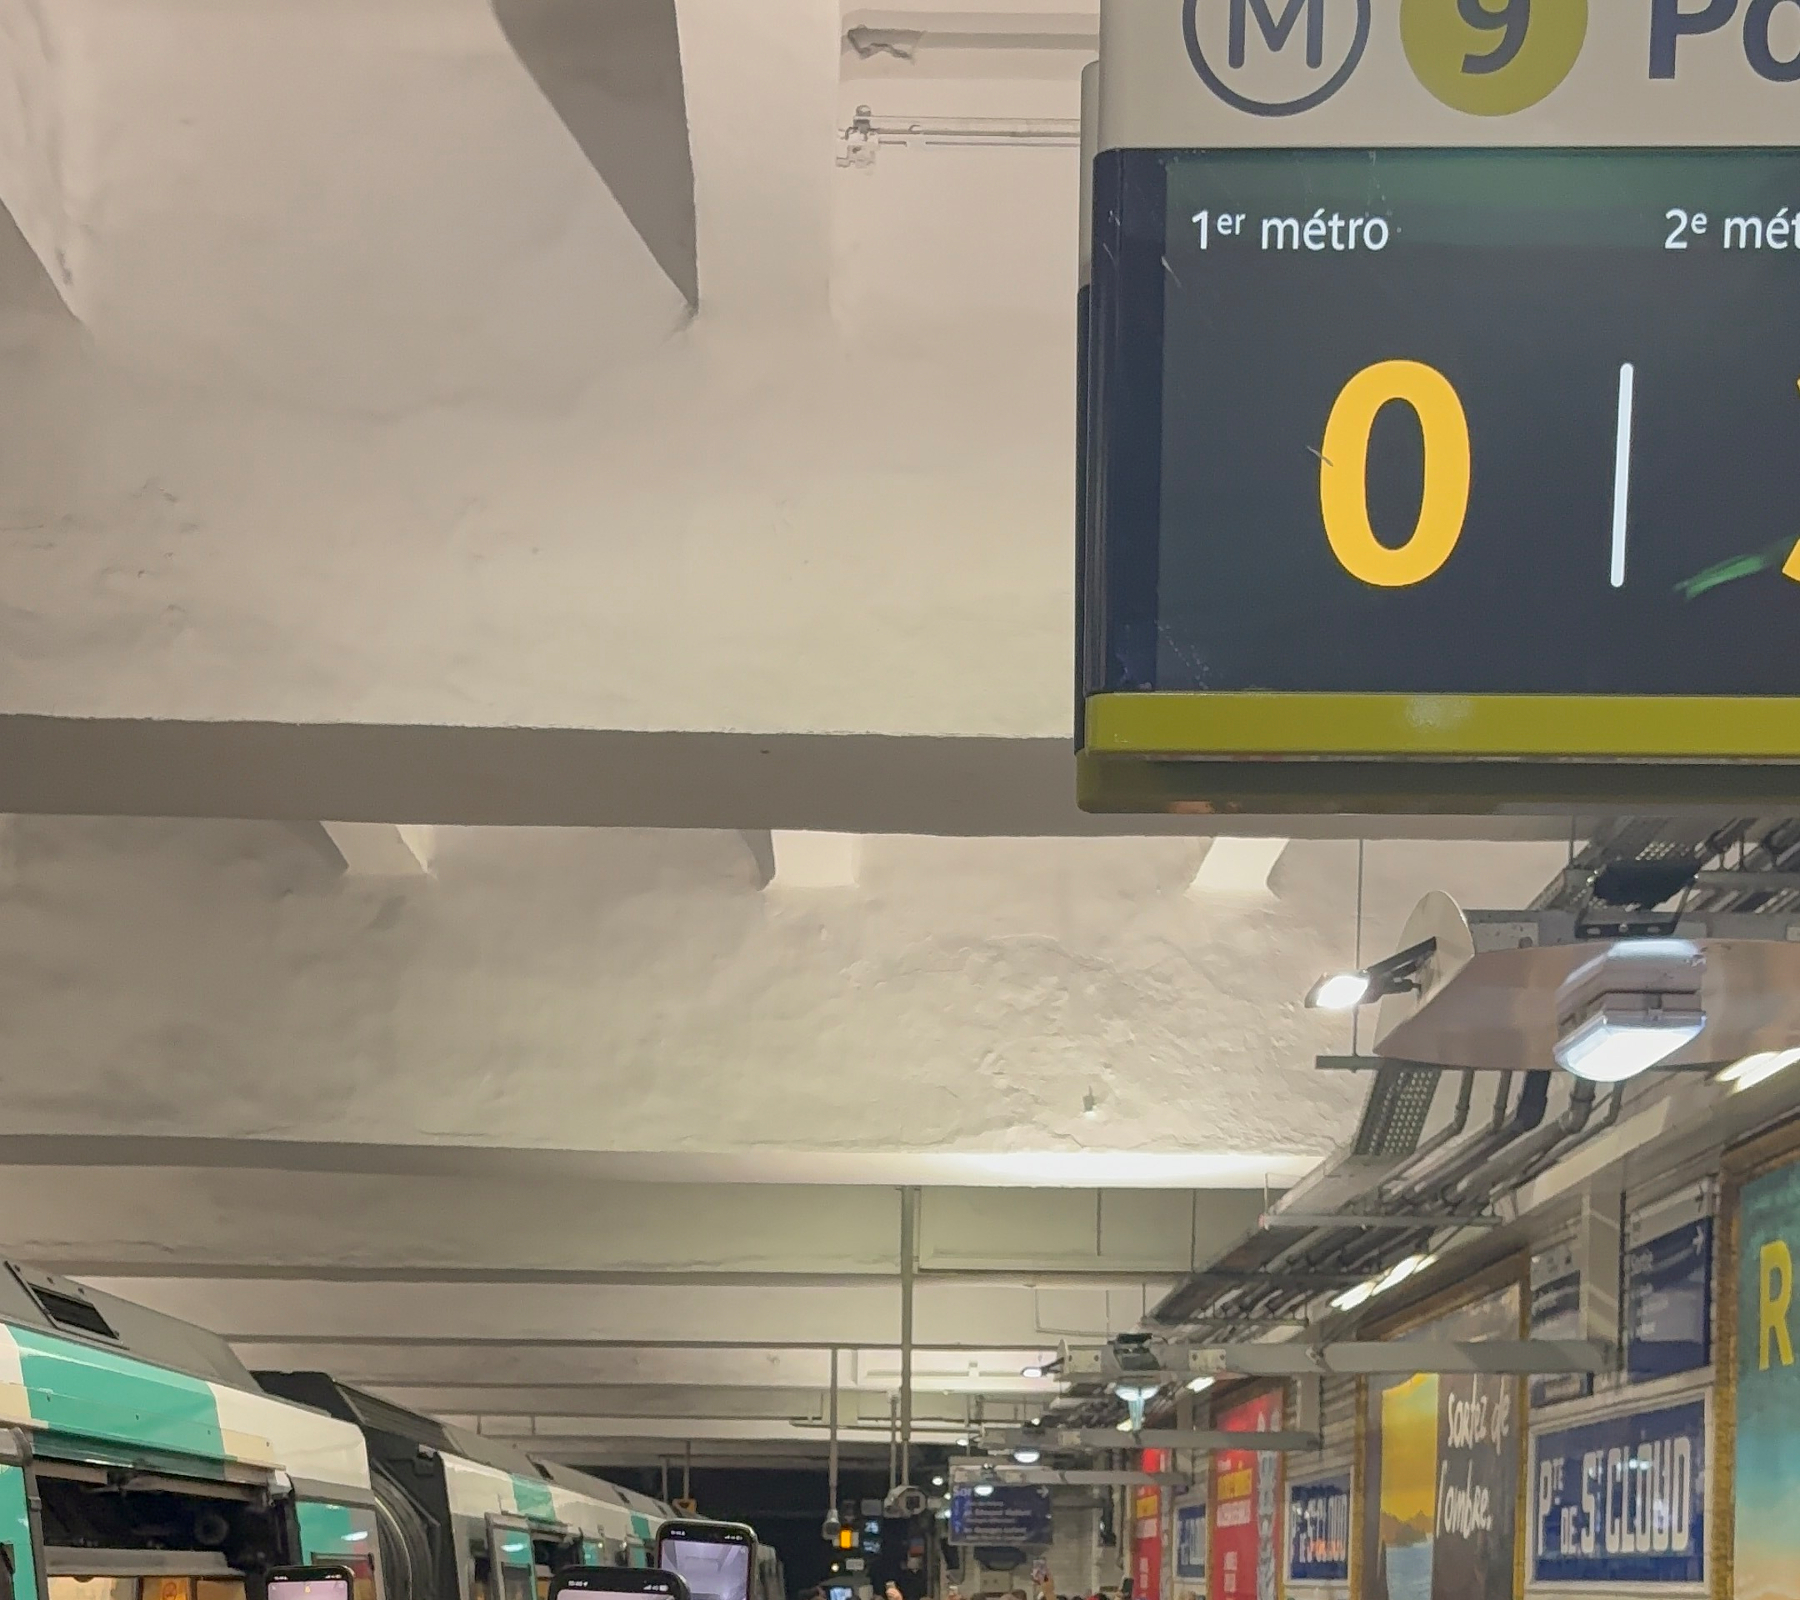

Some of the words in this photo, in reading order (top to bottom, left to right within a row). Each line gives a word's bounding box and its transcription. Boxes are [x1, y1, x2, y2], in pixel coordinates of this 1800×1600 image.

[1192, 209, 1246, 250] 1er
[1261, 208, 1389, 251] métro
[1664, 208, 1707, 249] 2e
[1319, 360, 1471, 587] 0
[1759, 1240, 1794, 1371] R
[1606, 1437, 1691, 1554] CLOUD
